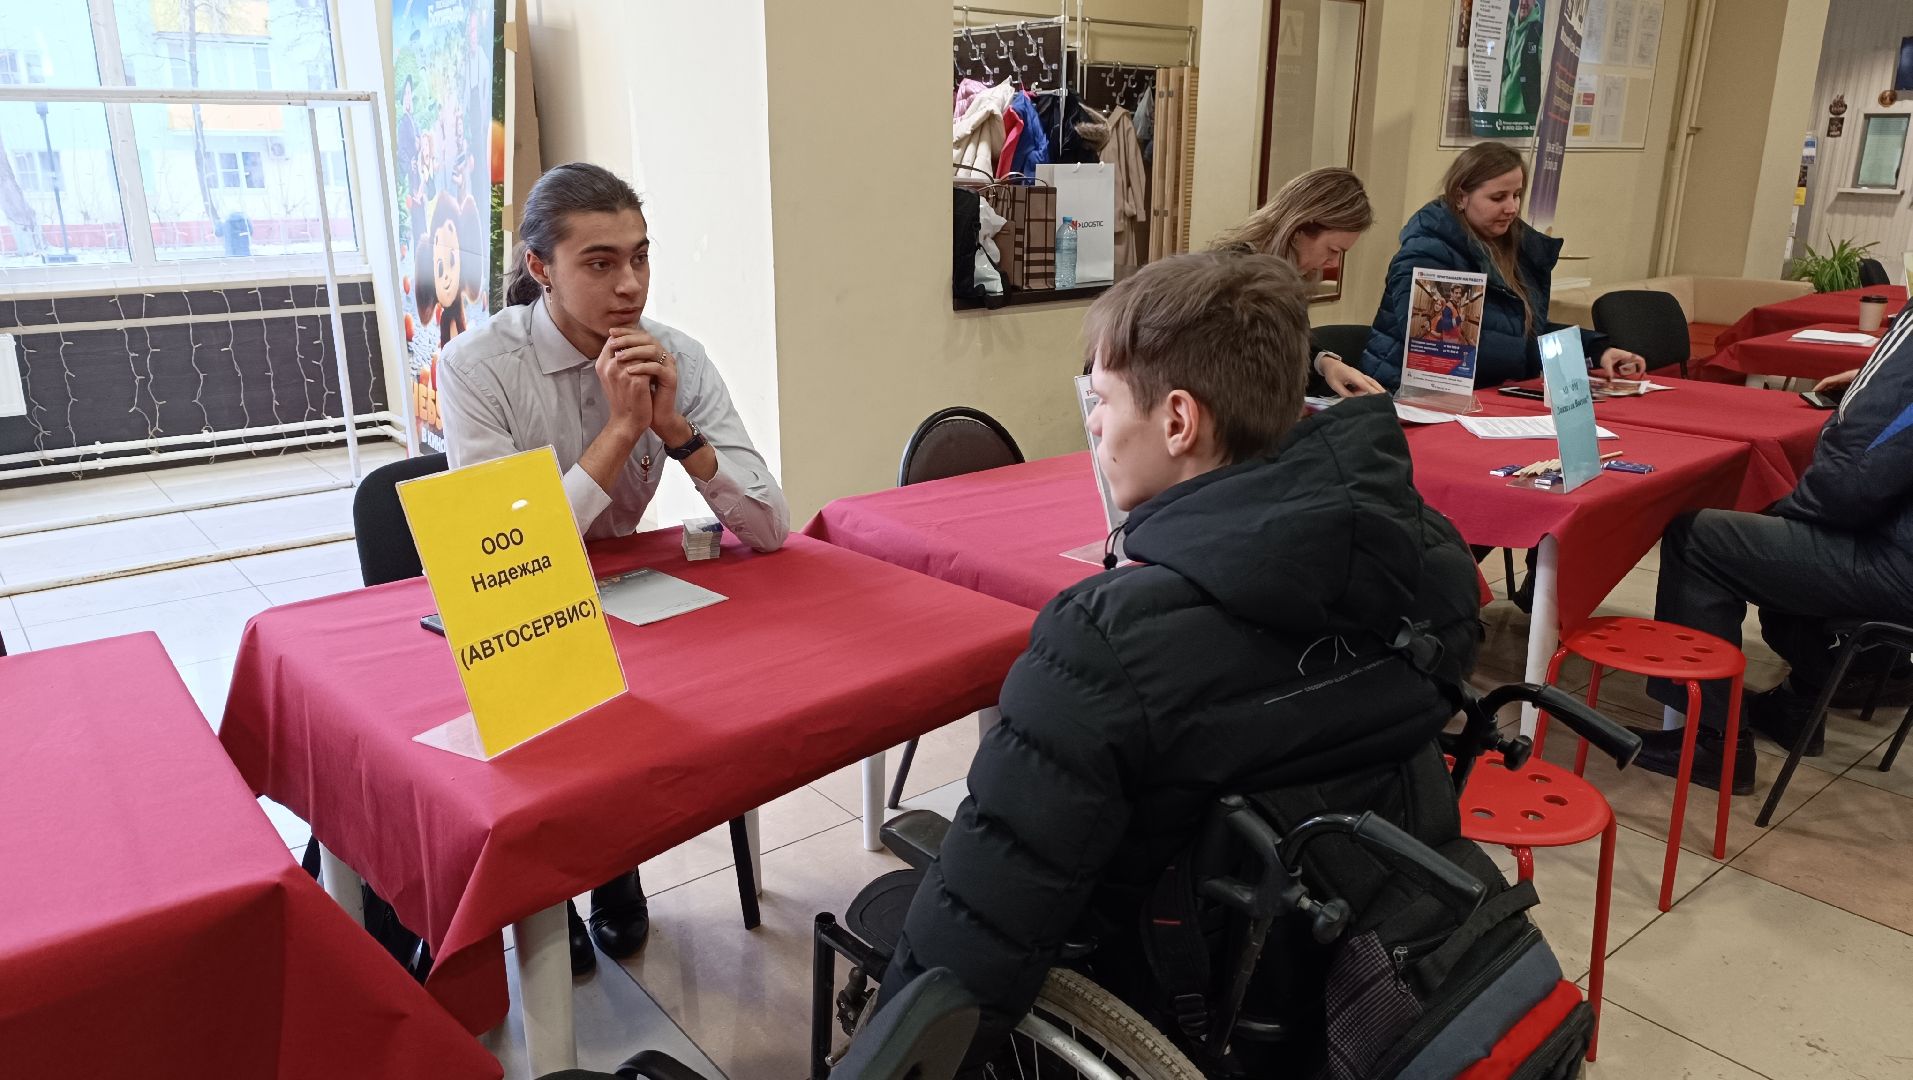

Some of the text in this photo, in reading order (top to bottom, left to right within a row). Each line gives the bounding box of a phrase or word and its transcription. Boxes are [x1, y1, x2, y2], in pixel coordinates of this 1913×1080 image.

[481, 528, 524, 555] ООО
[470, 553, 552, 593] Надежда
[460, 599, 597, 670] (АВТОСЕРВИС)
